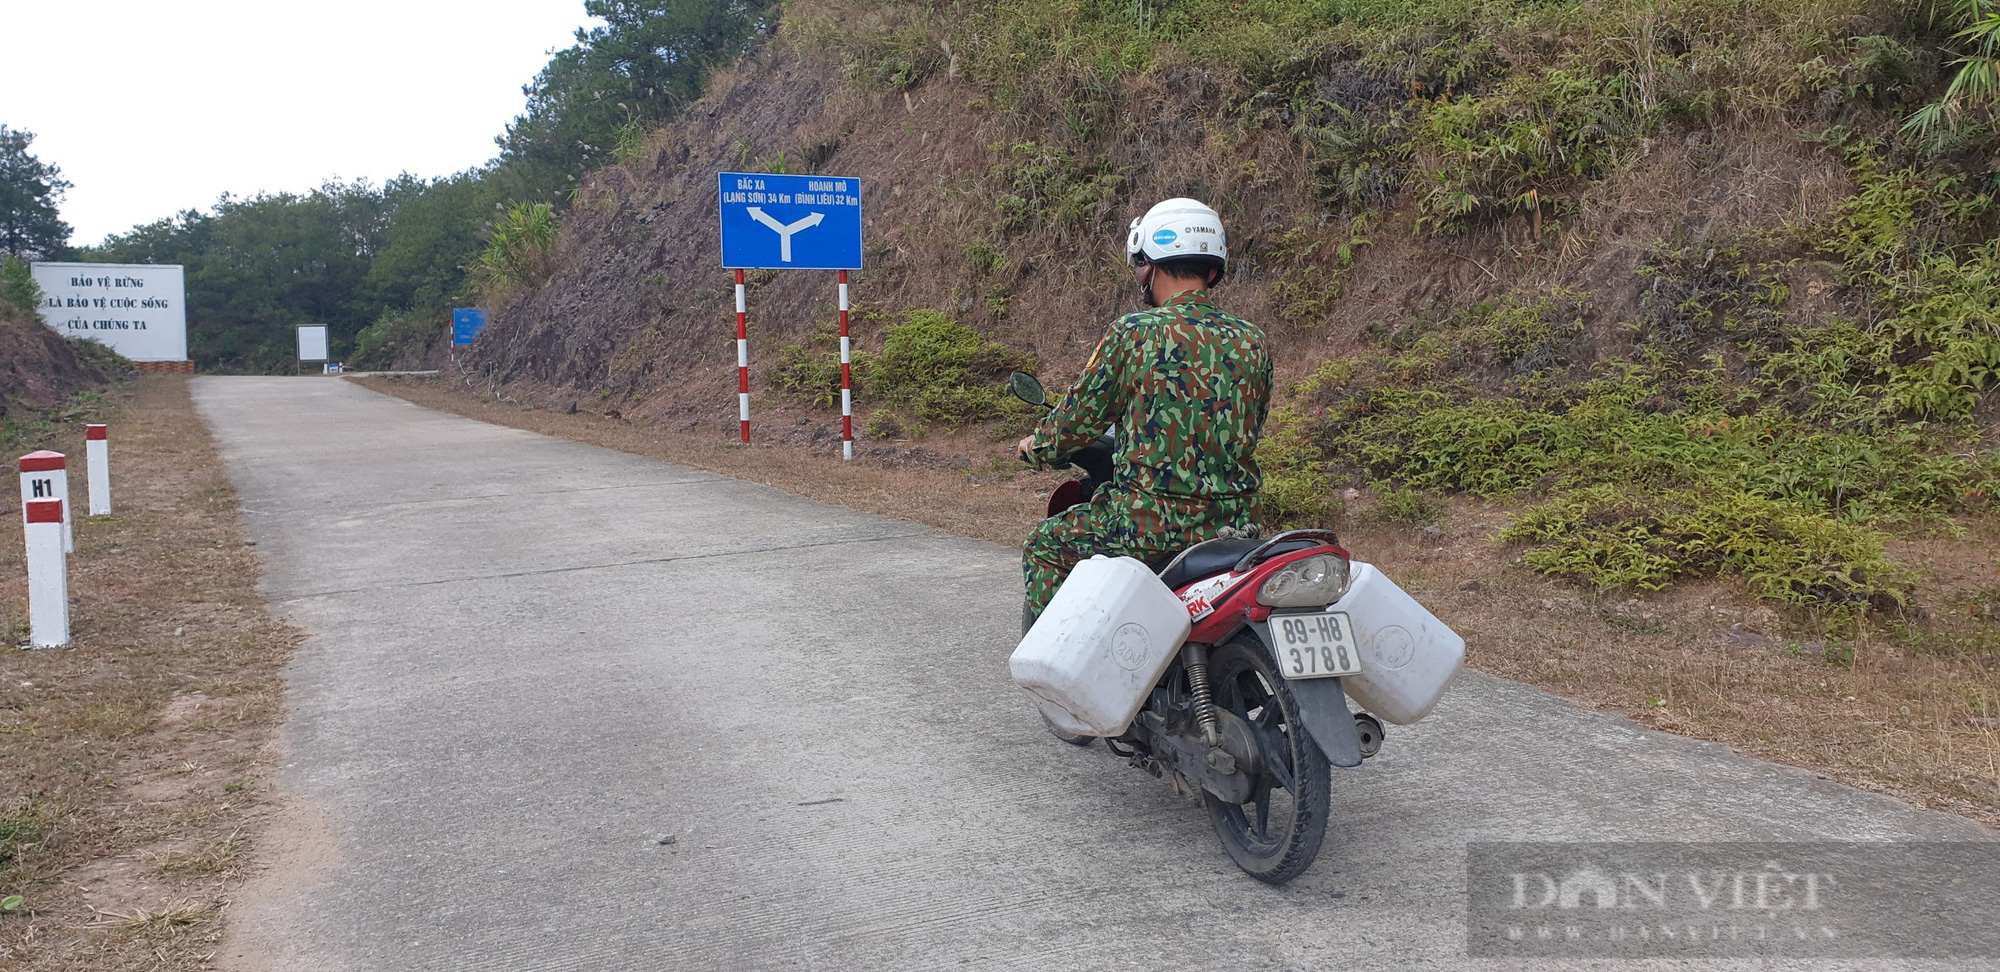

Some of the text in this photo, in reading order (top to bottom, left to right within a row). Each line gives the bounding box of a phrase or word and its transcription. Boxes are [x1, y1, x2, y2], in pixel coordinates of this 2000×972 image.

[737, 176, 766, 190] BẮC XA
[723, 191, 791, 204] (LẠNG SƠN) 34 Km
[794, 192, 858, 206] (BÌNH LIÊU) 32 Km
[1192, 226, 1216, 234] YAMAHA
[71, 274, 144, 290] BẢO VỆ RỪNG
[48, 294, 168, 311] LÀ BẢO VỆ CUỘC SỐNG
[67, 317, 147, 330] CỦA CHÚNG TA
[32, 479, 52, 497] H1
[1186, 595, 1210, 617] RK
[1282, 616, 1343, 645] 89-H8
[1289, 644, 1351, 674] 3788
